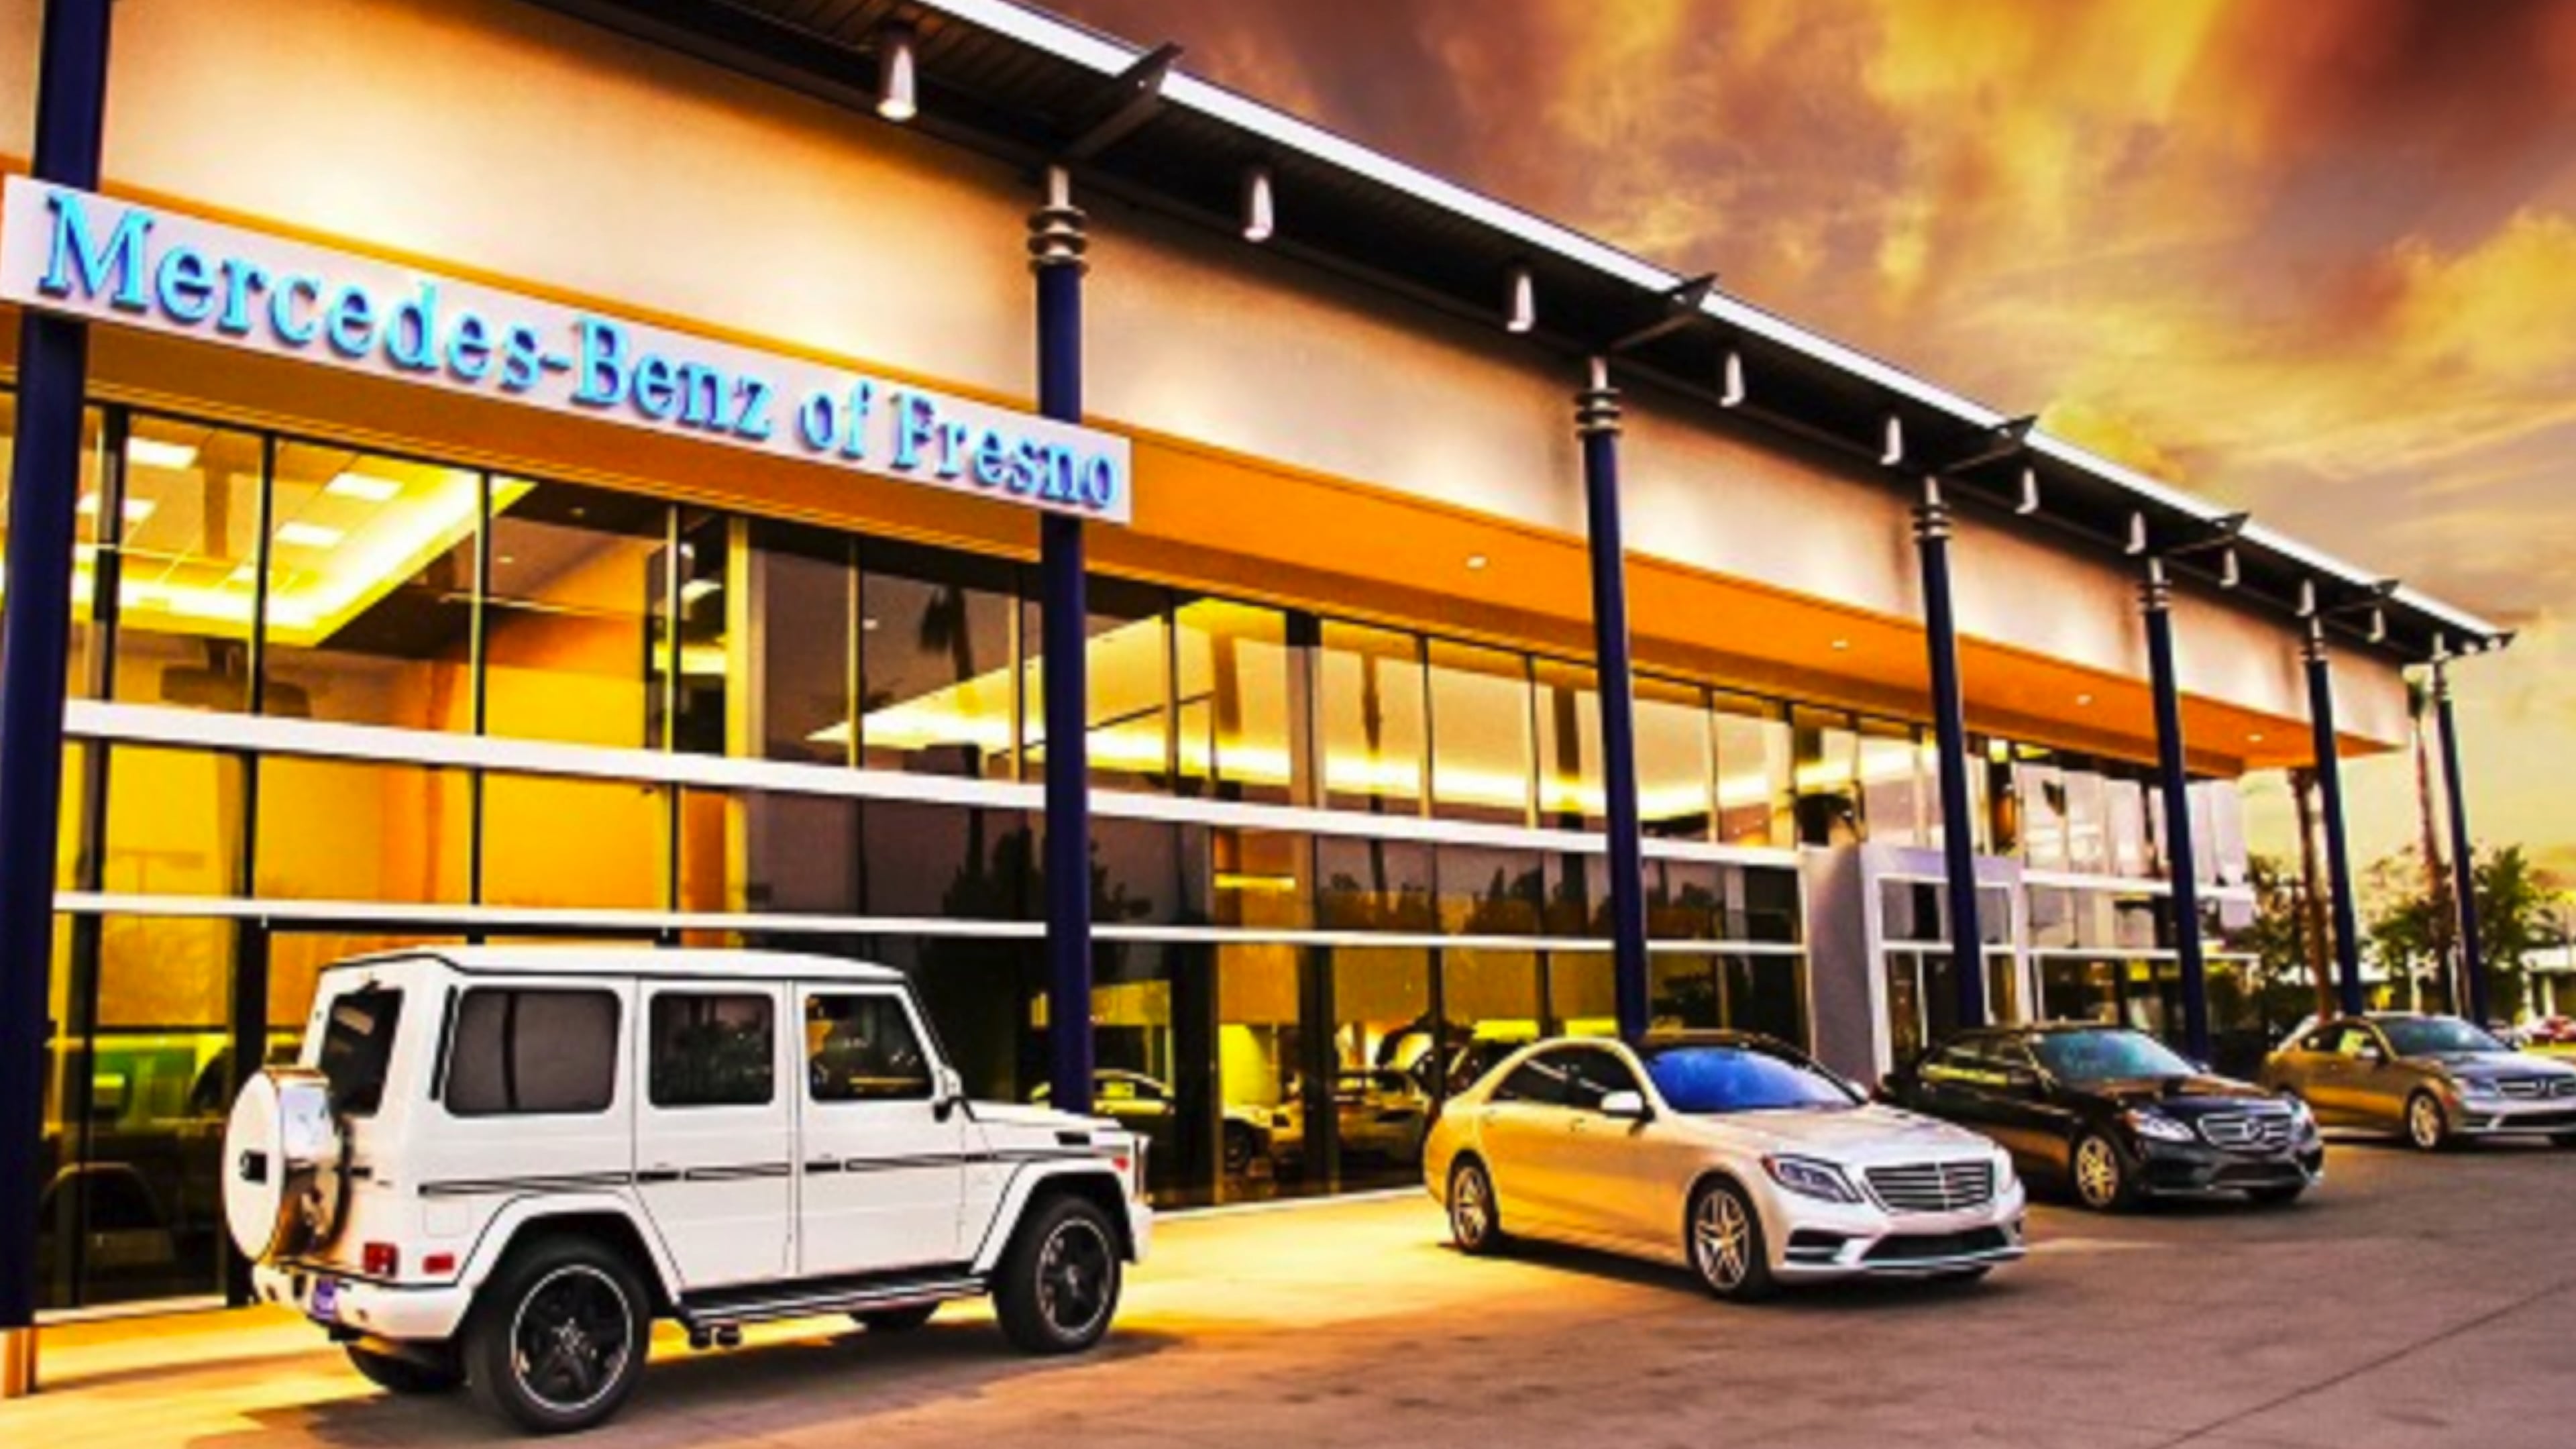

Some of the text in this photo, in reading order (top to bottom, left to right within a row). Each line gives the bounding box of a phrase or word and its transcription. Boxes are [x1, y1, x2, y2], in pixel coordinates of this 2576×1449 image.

[39, 190, 1119, 510] Mercedes-Benz of Fresno
